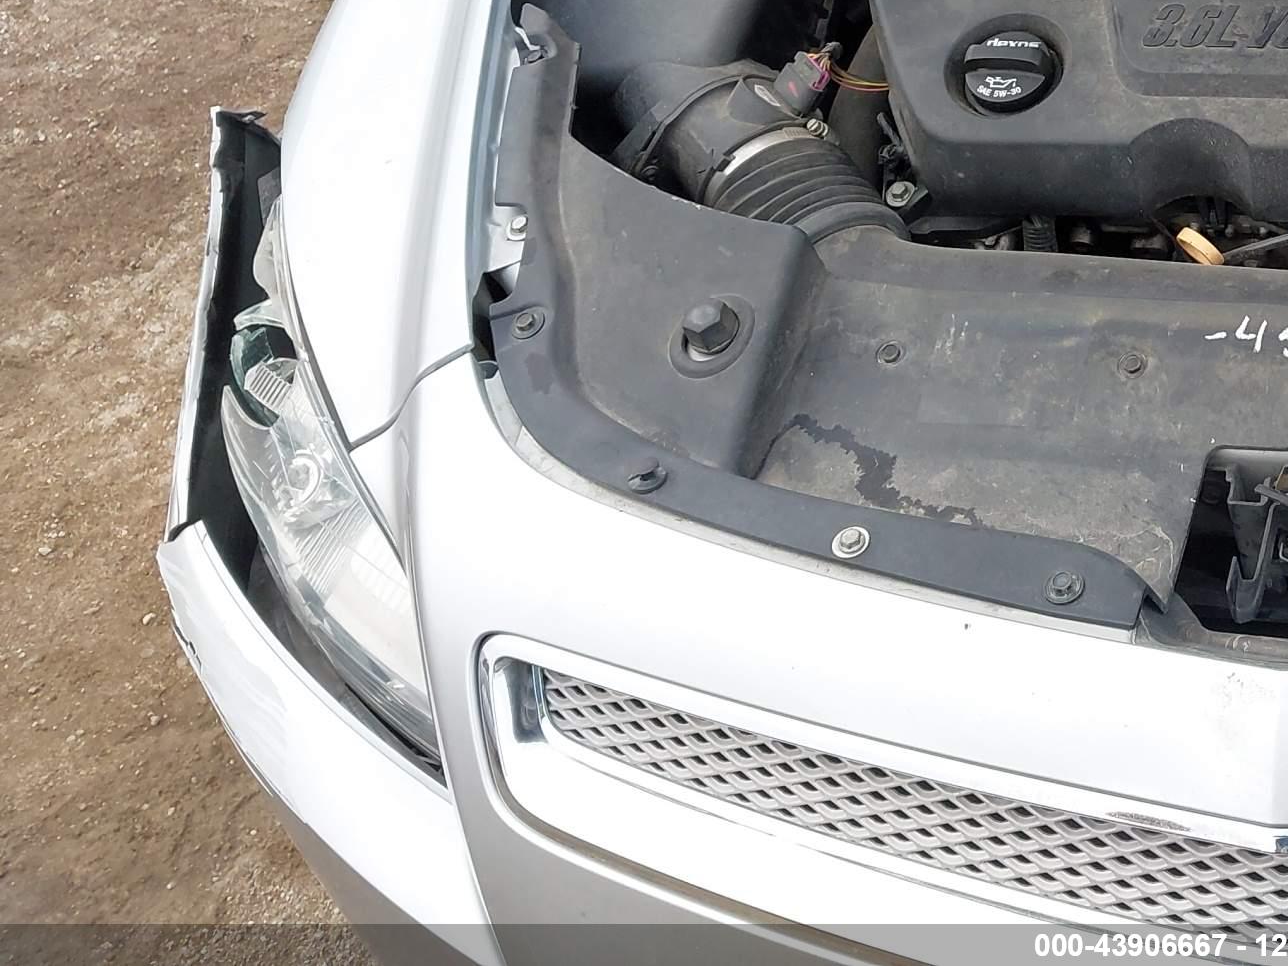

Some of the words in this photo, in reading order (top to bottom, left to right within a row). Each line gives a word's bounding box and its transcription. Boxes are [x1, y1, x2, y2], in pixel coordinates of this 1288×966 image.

[1142, 4, 1240, 48] 3.6L
[976, 85, 993, 97] SAE
[993, 86, 1022, 98] 5W-30
